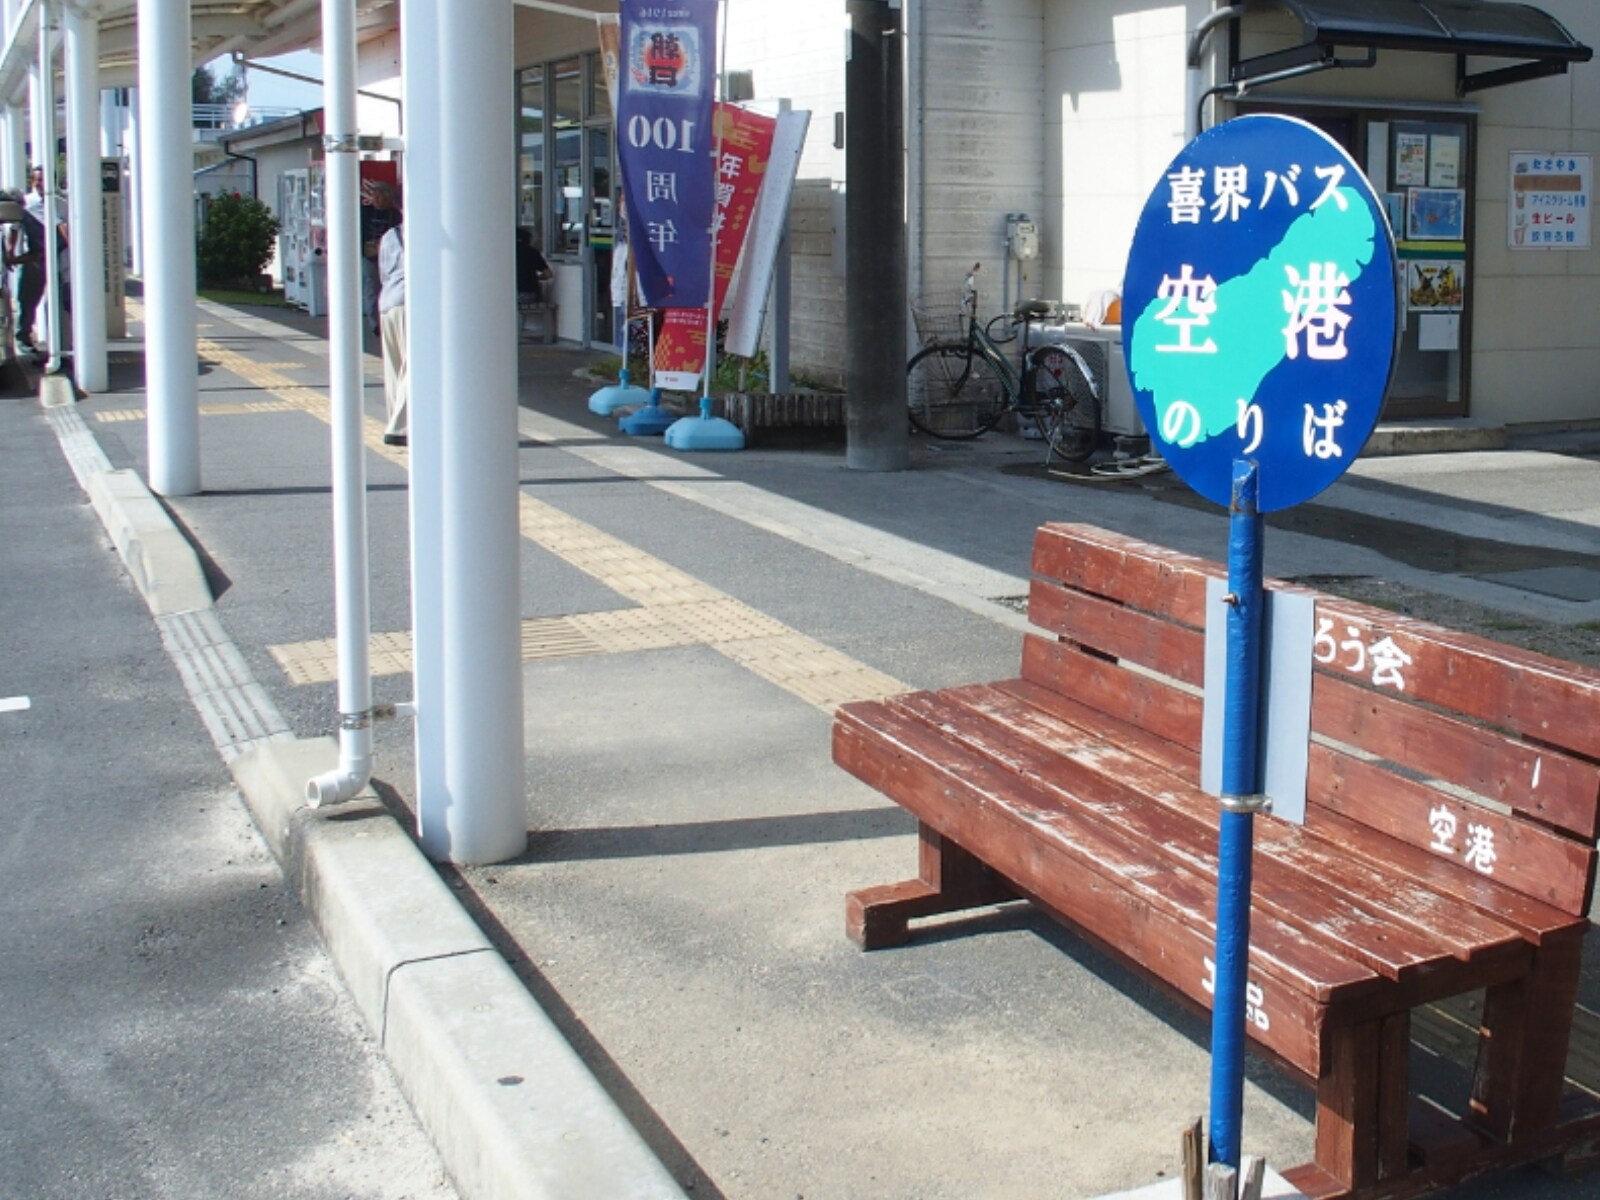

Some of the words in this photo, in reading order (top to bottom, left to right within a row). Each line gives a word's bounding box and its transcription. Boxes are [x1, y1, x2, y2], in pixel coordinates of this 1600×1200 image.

[1166, 164, 1349, 225] 喜界バス
[1531, 212, 1576, 225] 生ビール
[1153, 262, 1353, 360] 空港
[1162, 399, 1347, 459] のりば
[1313, 617, 1412, 690] ろう会
[1428, 804, 1497, 875] 空港
